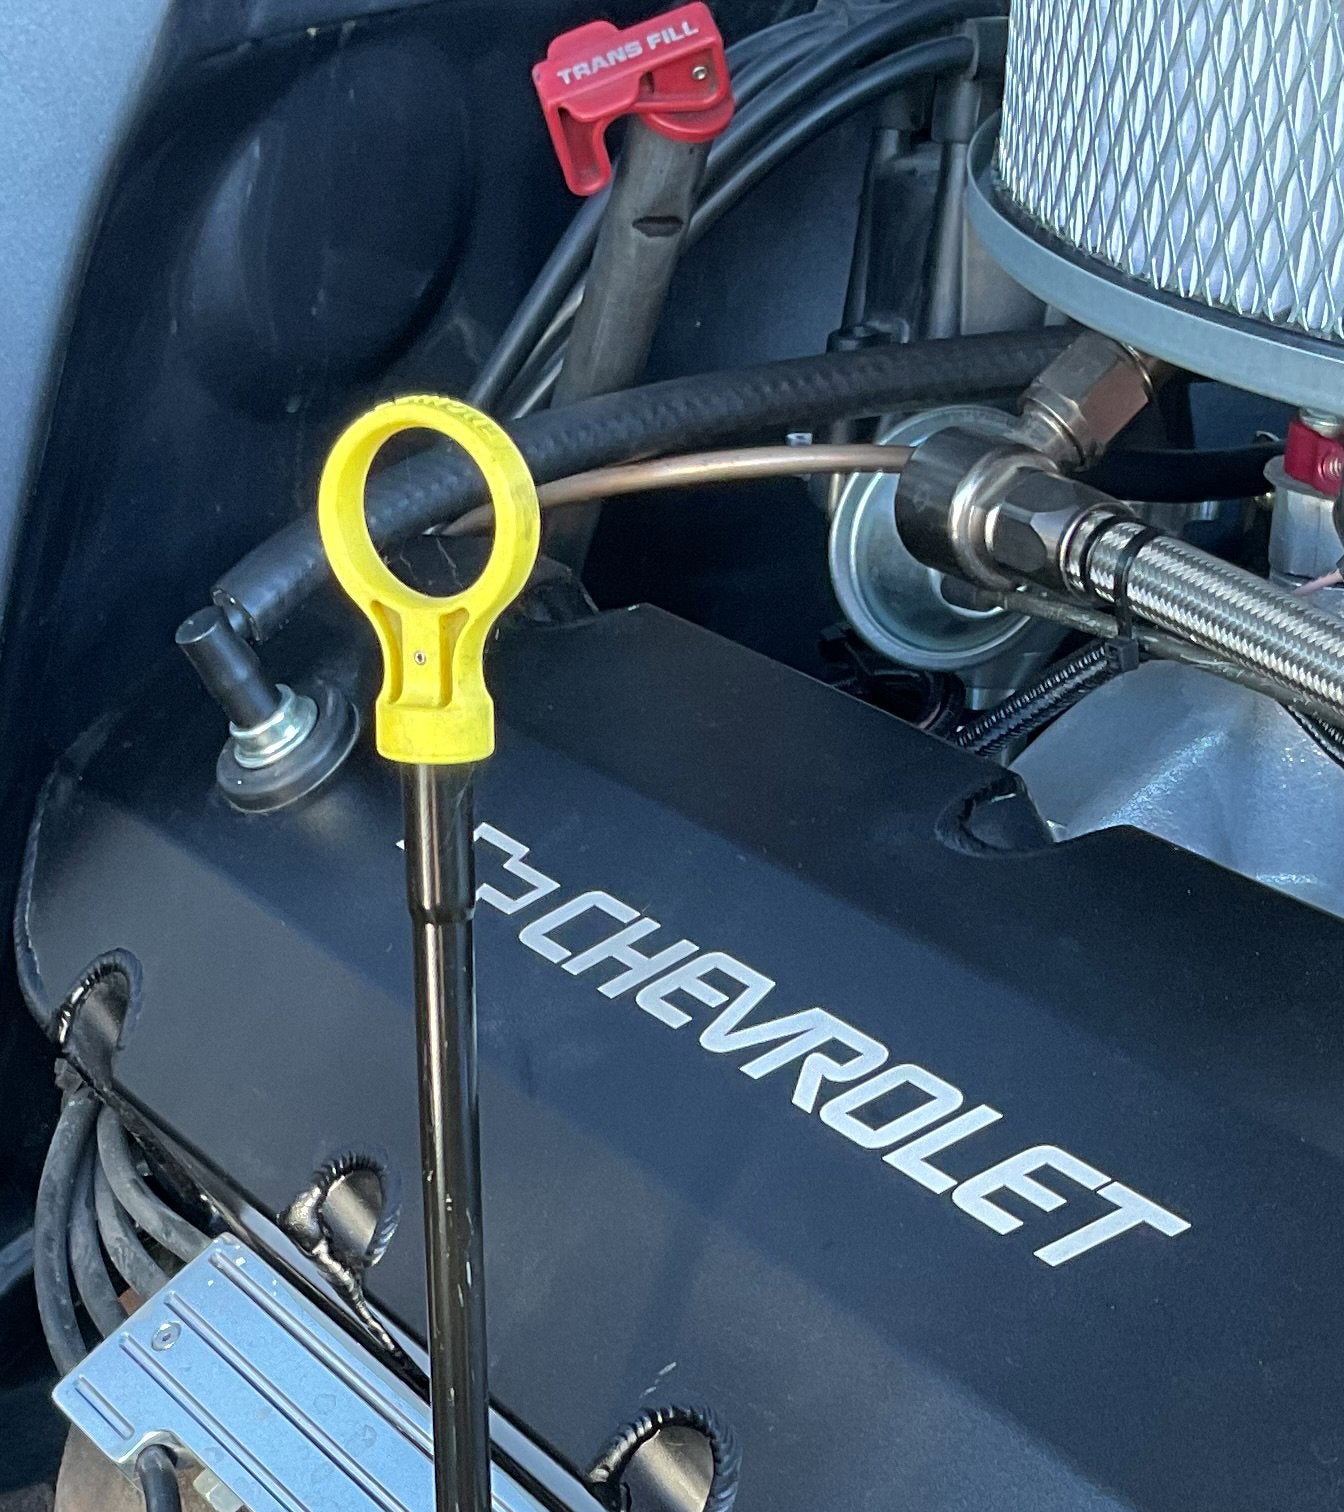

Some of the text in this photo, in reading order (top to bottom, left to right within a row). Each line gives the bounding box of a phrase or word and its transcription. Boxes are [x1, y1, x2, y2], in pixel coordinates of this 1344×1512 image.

[557, 21, 699, 85] TRANS FILL
[518, 890, 1193, 1267] CHEVROLET
